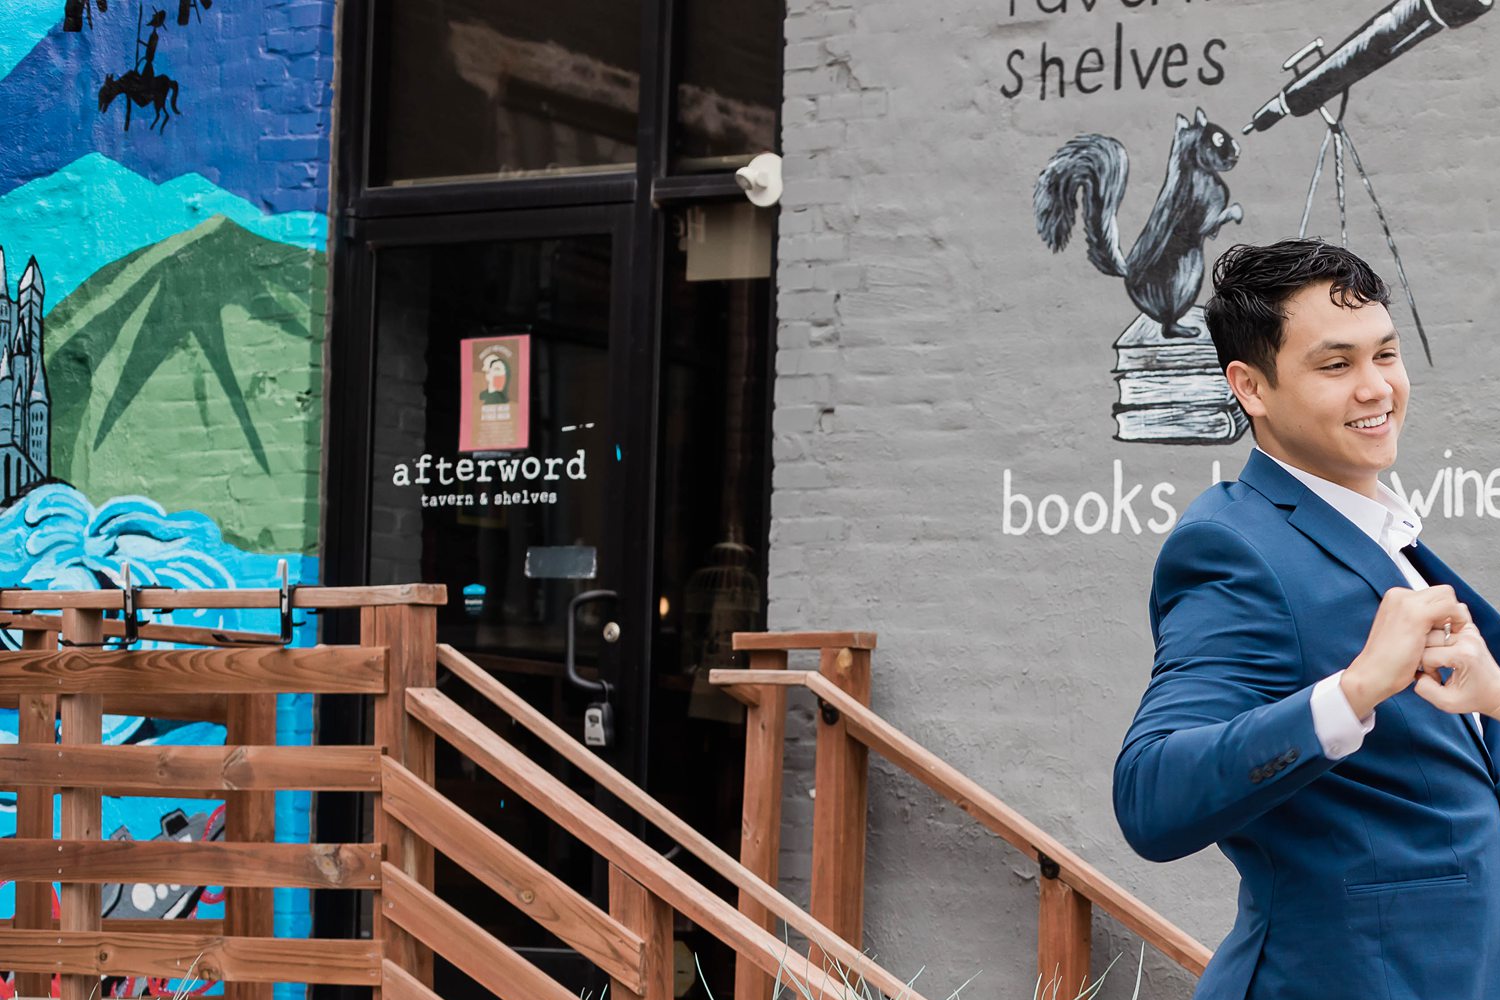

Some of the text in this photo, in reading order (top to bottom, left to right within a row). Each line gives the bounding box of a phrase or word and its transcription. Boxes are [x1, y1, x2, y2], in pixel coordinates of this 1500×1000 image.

[1000, 22, 1227, 101] shelves
[392, 448, 587, 487] afterword
[421, 489, 558, 508] tavern & shelves
[1002, 459, 1178, 536] books
